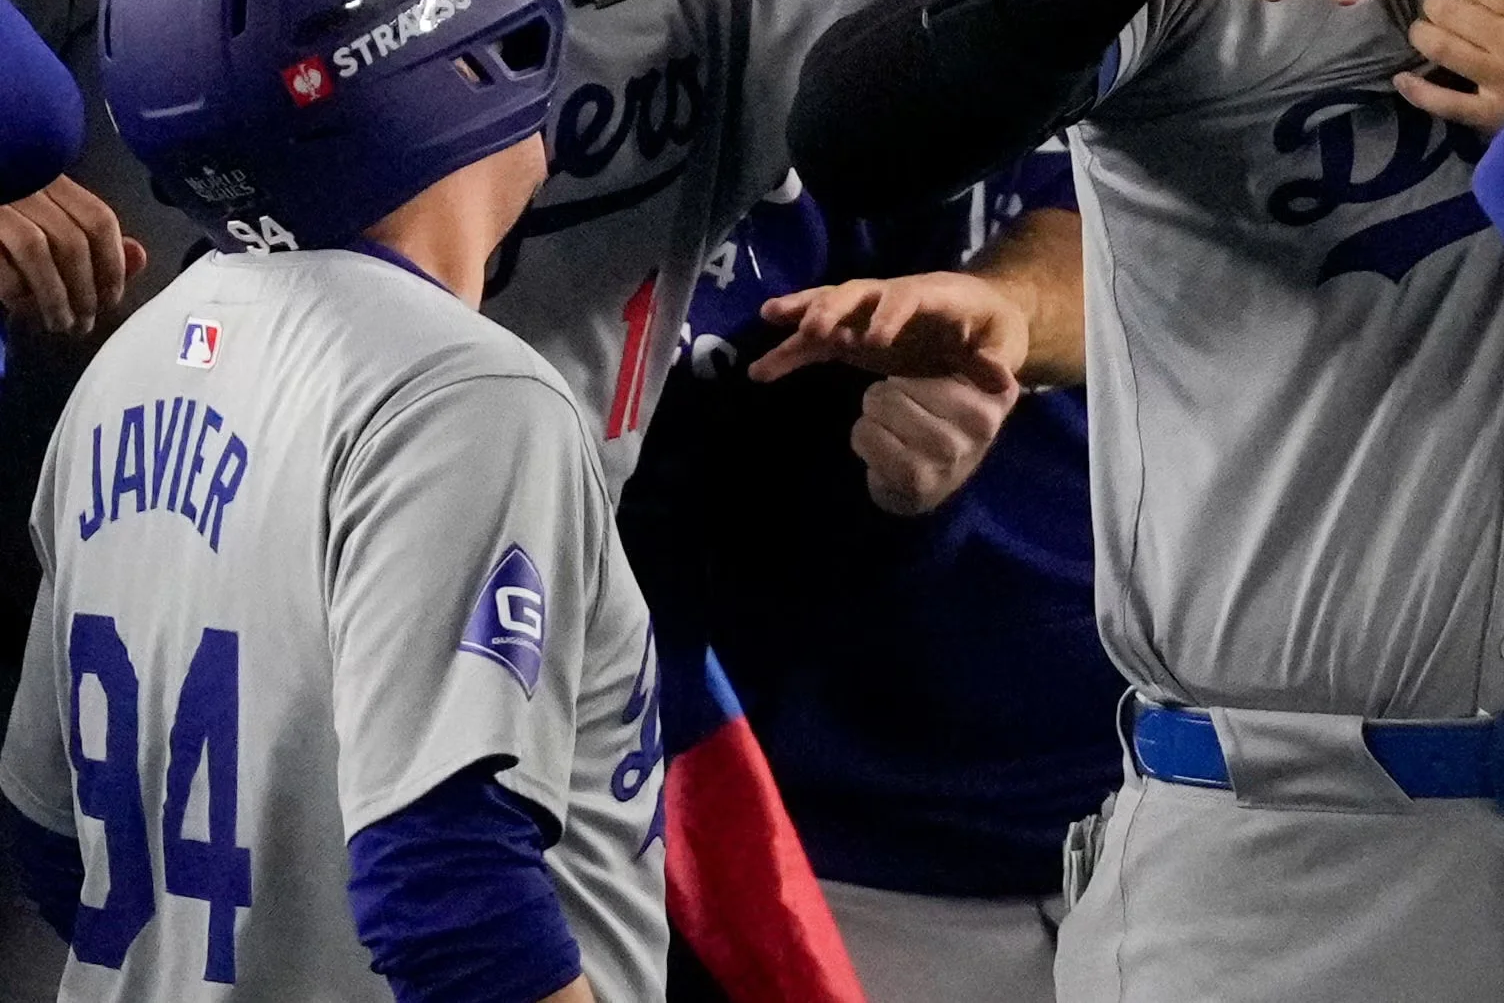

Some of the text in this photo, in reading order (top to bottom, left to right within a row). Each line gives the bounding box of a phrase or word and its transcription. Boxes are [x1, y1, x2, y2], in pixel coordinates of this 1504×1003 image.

[227, 215, 299, 255] 94
[79, 396, 249, 554] JAVIER
[68, 612, 253, 985] 94
